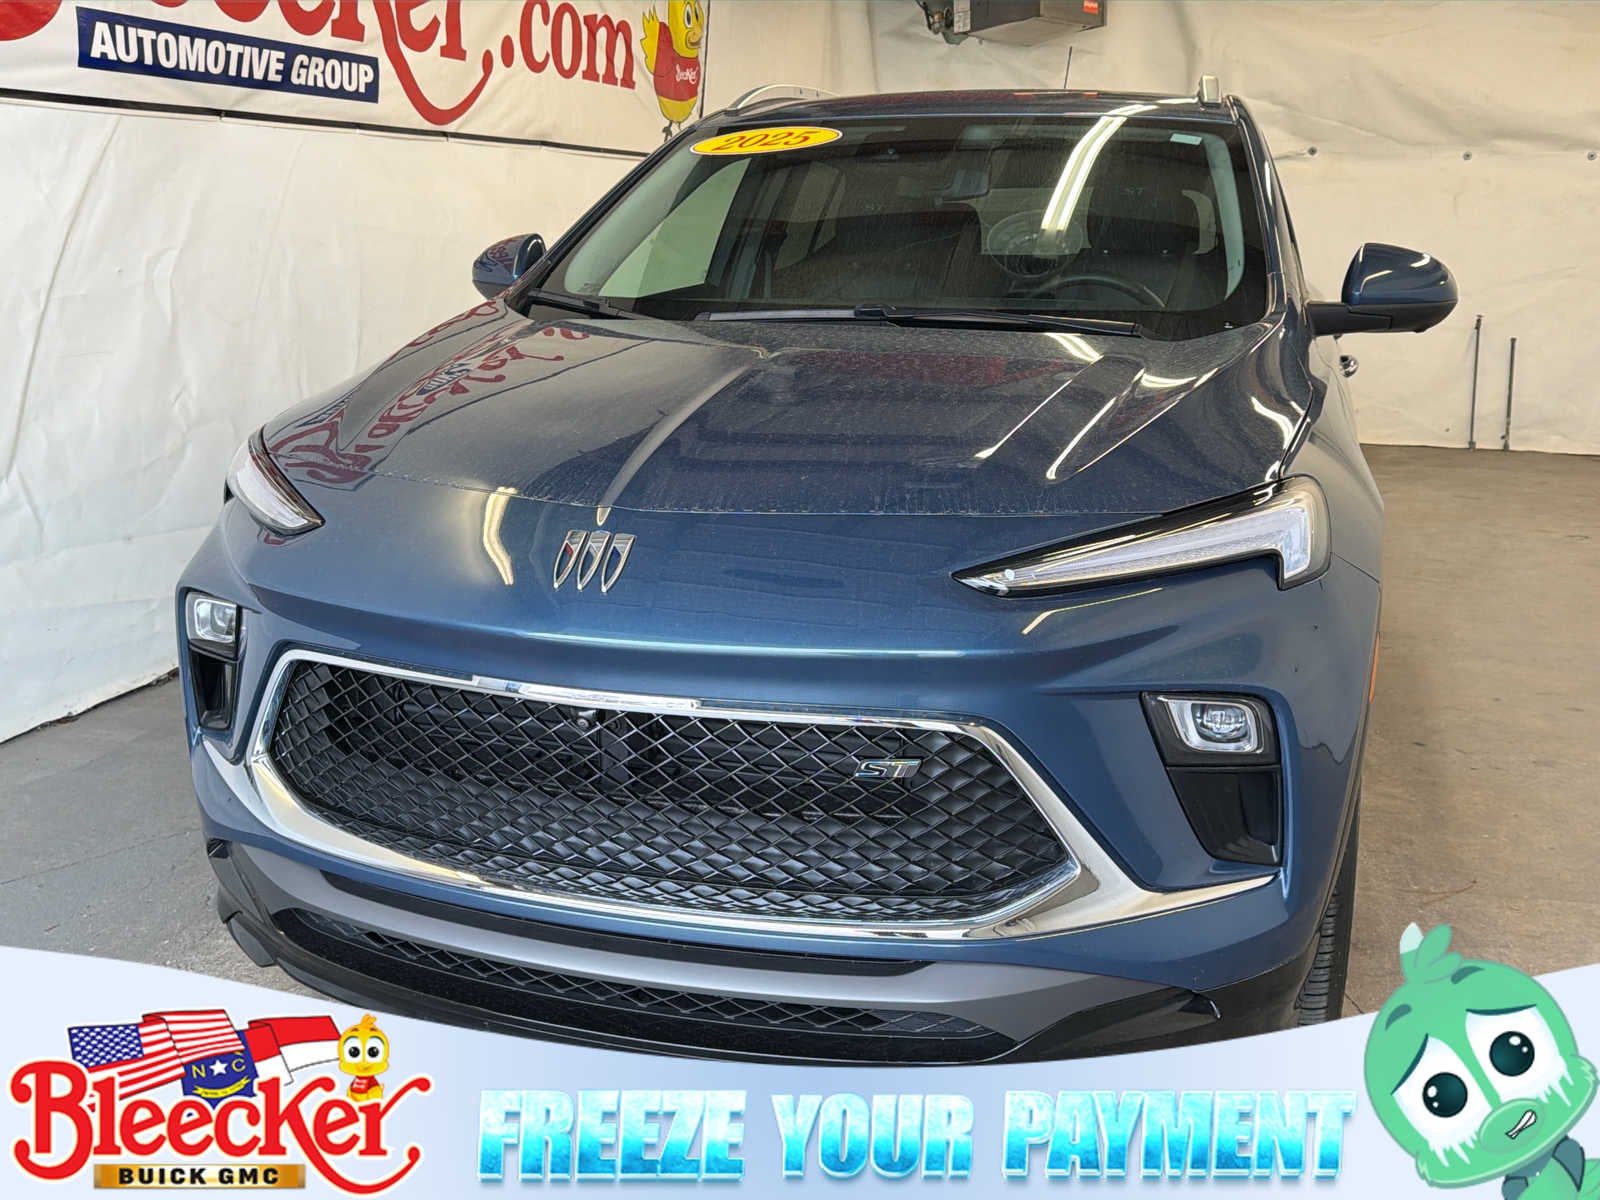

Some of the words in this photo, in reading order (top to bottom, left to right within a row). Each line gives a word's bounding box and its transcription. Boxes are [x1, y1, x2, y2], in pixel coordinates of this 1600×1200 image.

[90, 21, 285, 83] AUTOMOTIVE
[290, 54, 375, 94] GROUP
[712, 131, 821, 151] 2025
[855, 760, 919, 778] ST
